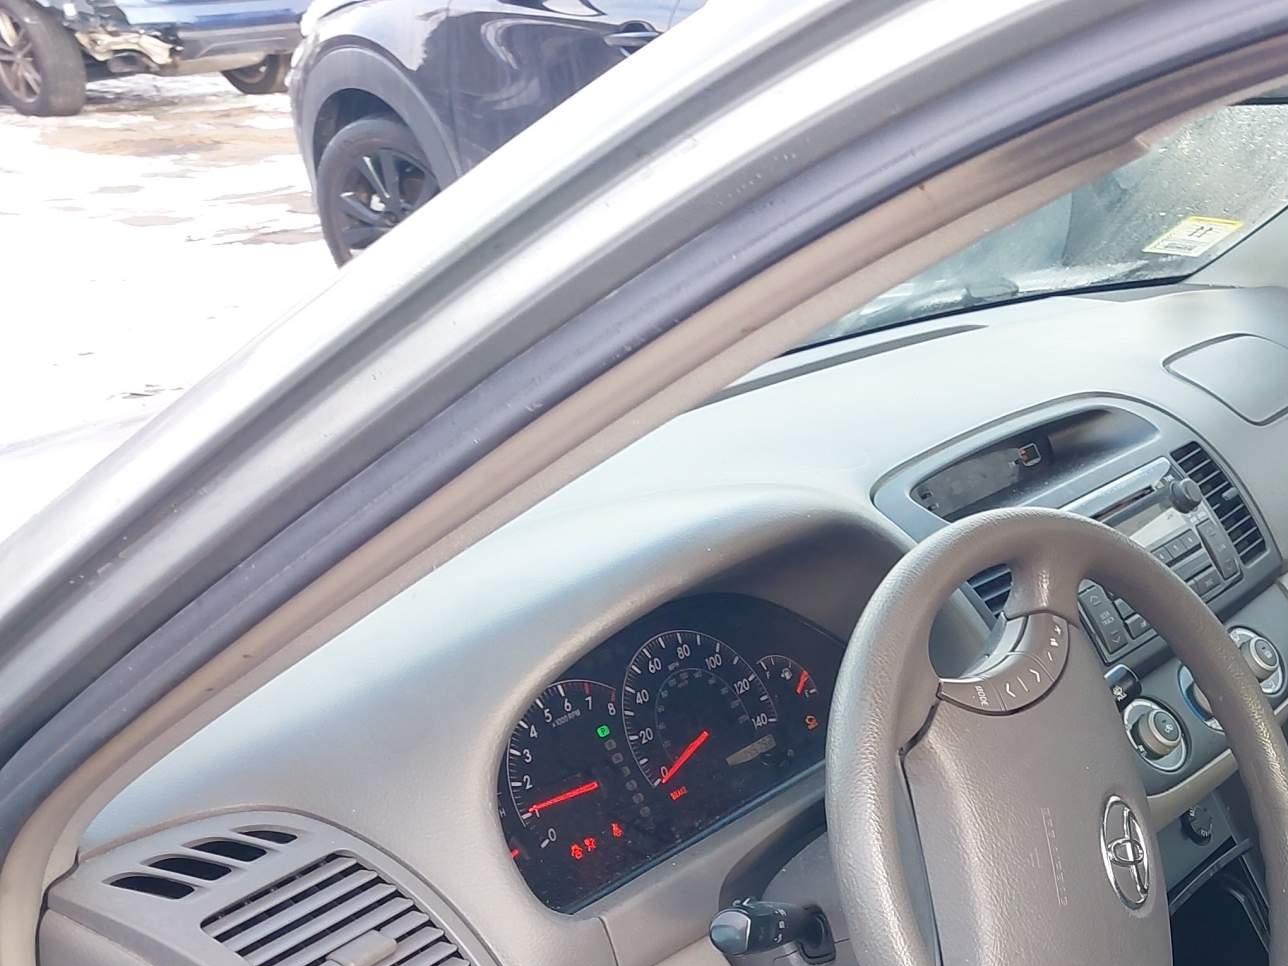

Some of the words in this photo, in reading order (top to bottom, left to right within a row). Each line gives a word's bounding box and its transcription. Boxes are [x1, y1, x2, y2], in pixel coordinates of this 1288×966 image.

[677, 644, 690, 659] 80
[648, 658, 662, 673] 60
[705, 654, 722, 670] 100
[734, 679, 750, 695] 120
[585, 696, 592, 710] 7
[636, 689, 649, 704] 40
[564, 698, 572, 712] 6
[607, 703, 616, 716] 8
[544, 708, 552, 722] 5
[752, 713, 768, 729] 140
[529, 725, 538, 738] 4
[640, 728, 653, 744] 20
[523, 749, 532, 763] 3
[660, 766, 668, 778] 0
[523, 775, 533, 790] 2
[548, 828, 556, 841] 0
